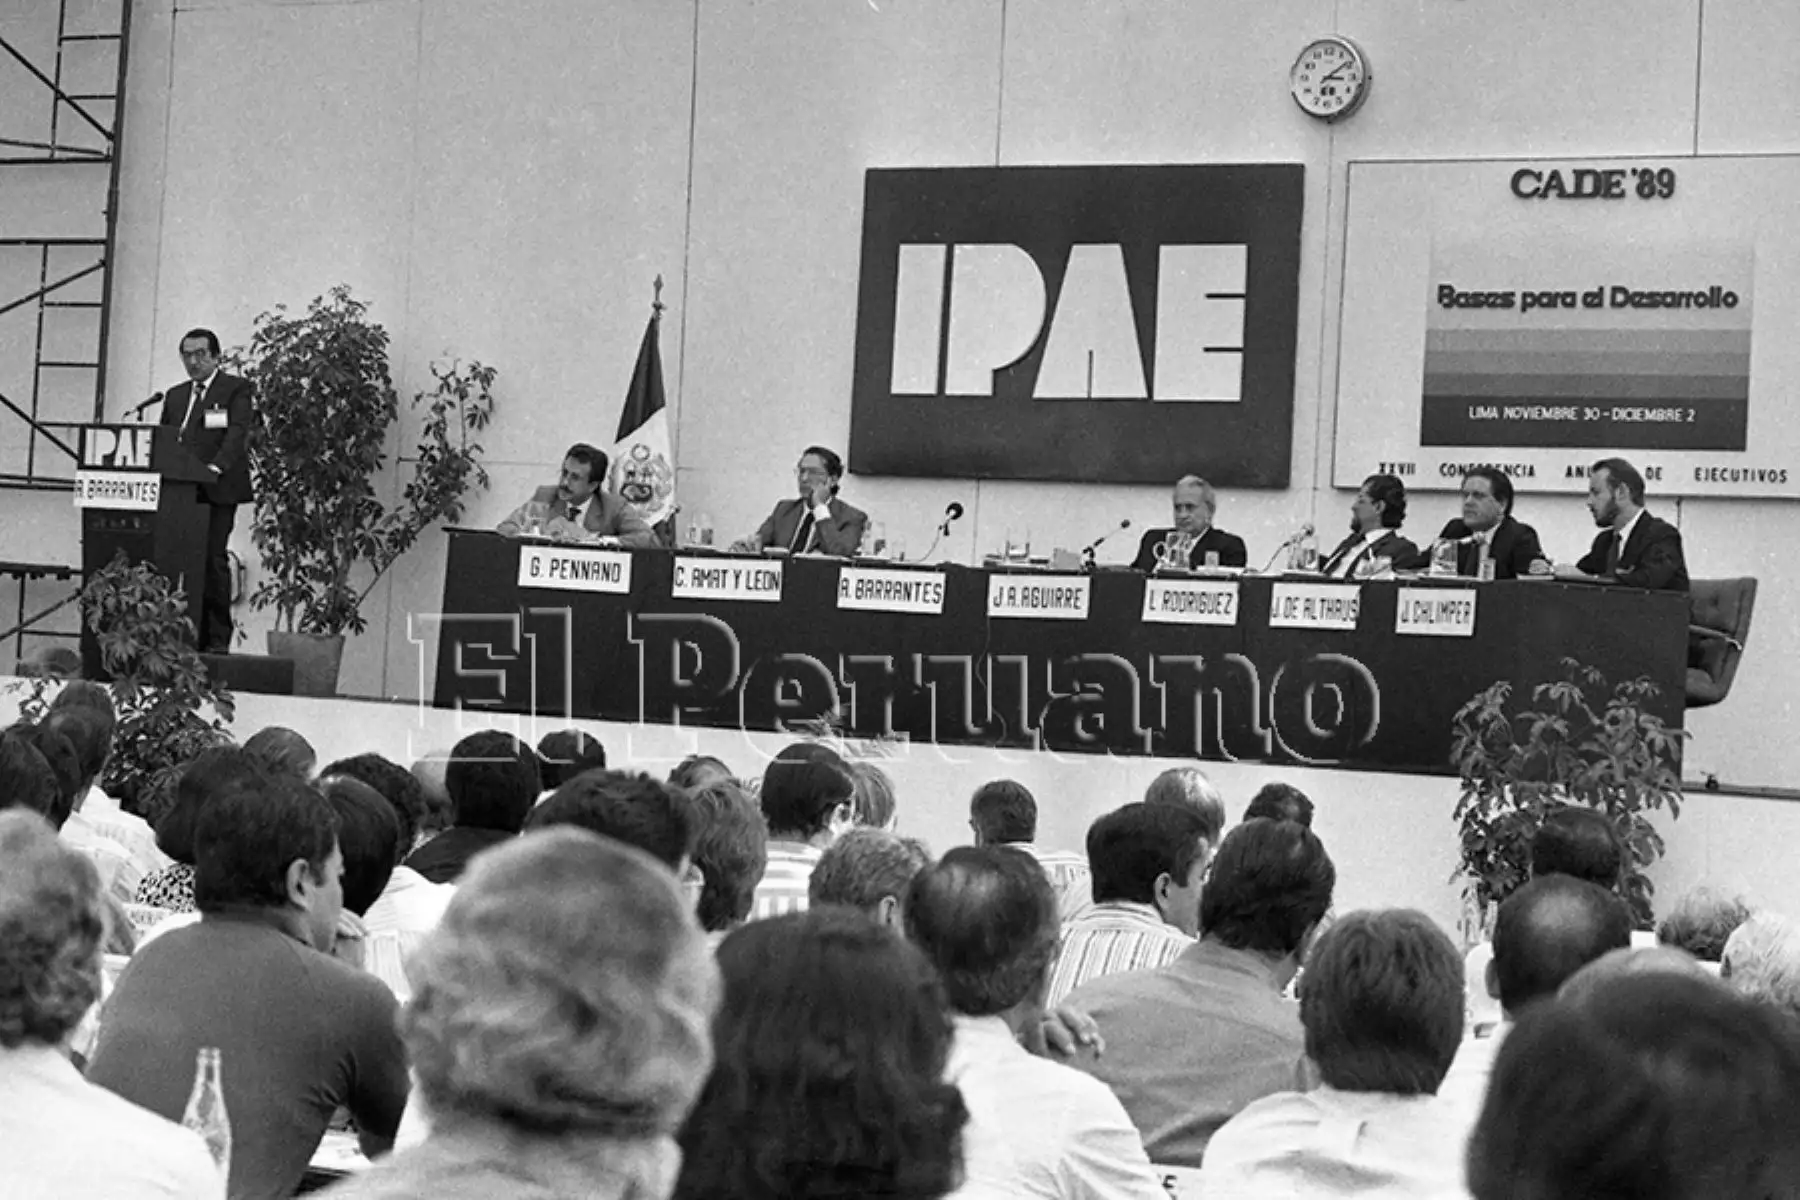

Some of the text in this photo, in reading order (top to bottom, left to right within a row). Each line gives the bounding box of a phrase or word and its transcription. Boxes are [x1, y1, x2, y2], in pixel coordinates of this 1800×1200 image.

[1437, 284, 1740, 313] Bases para el Desarrollo
[890, 243, 1248, 402] IPAE
[1469, 406, 1499, 420] LIMA
[1503, 406, 1579, 421] NOVIEMBRE
[1686, 409, 1696, 422] 2
[84, 428, 152, 467] IPAE
[1645, 466, 1663, 481] DE
[1694, 467, 1788, 484] EJECUTIVOS
[549, 558, 622, 584] PENNANO
[692, 567, 728, 589] AMAT
[733, 569, 742, 590] Y
[745, 569, 780, 591] LEON
[855, 578, 943, 605] BARRANTES
